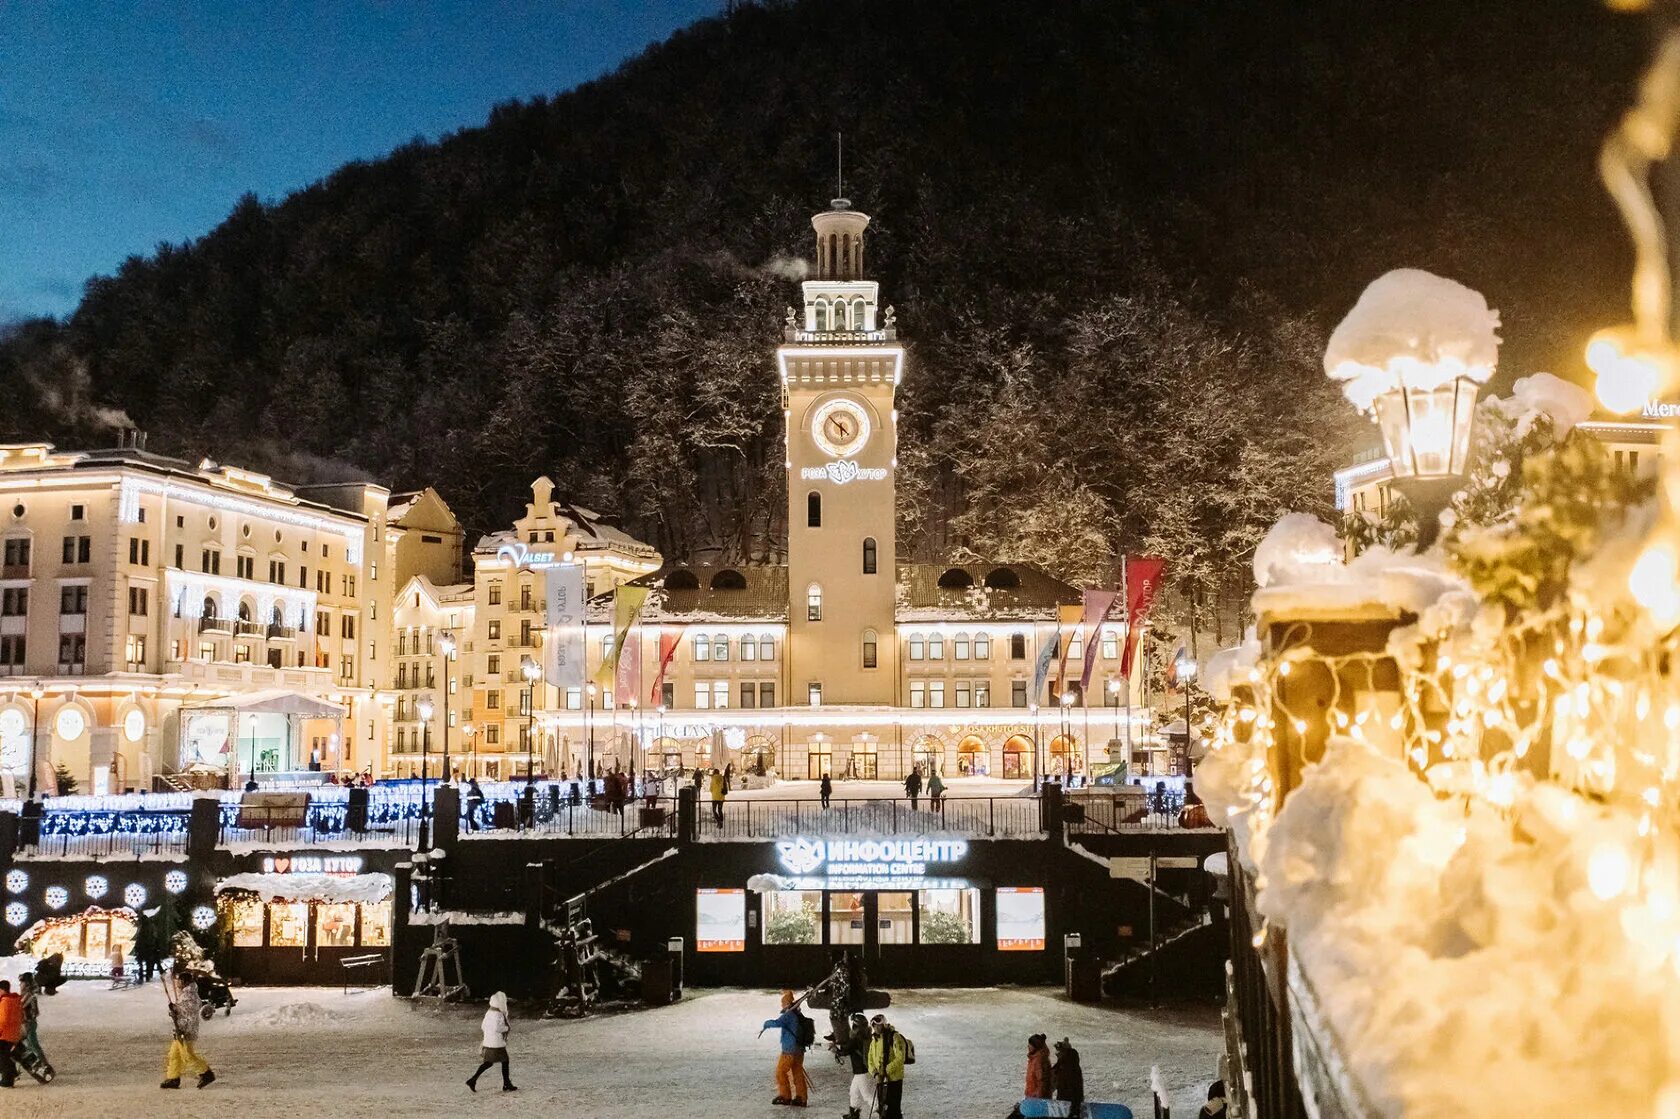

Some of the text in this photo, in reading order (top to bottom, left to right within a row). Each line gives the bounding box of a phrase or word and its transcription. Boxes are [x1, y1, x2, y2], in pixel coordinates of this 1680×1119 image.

[1642, 399, 1680, 416] Mer
[802, 468, 827, 479] РОЗА
[498, 543, 555, 568] VALSET
[828, 840, 967, 863] ИНФОЦЕНТР
[828, 863, 926, 875] INFORMATION CENTRE
